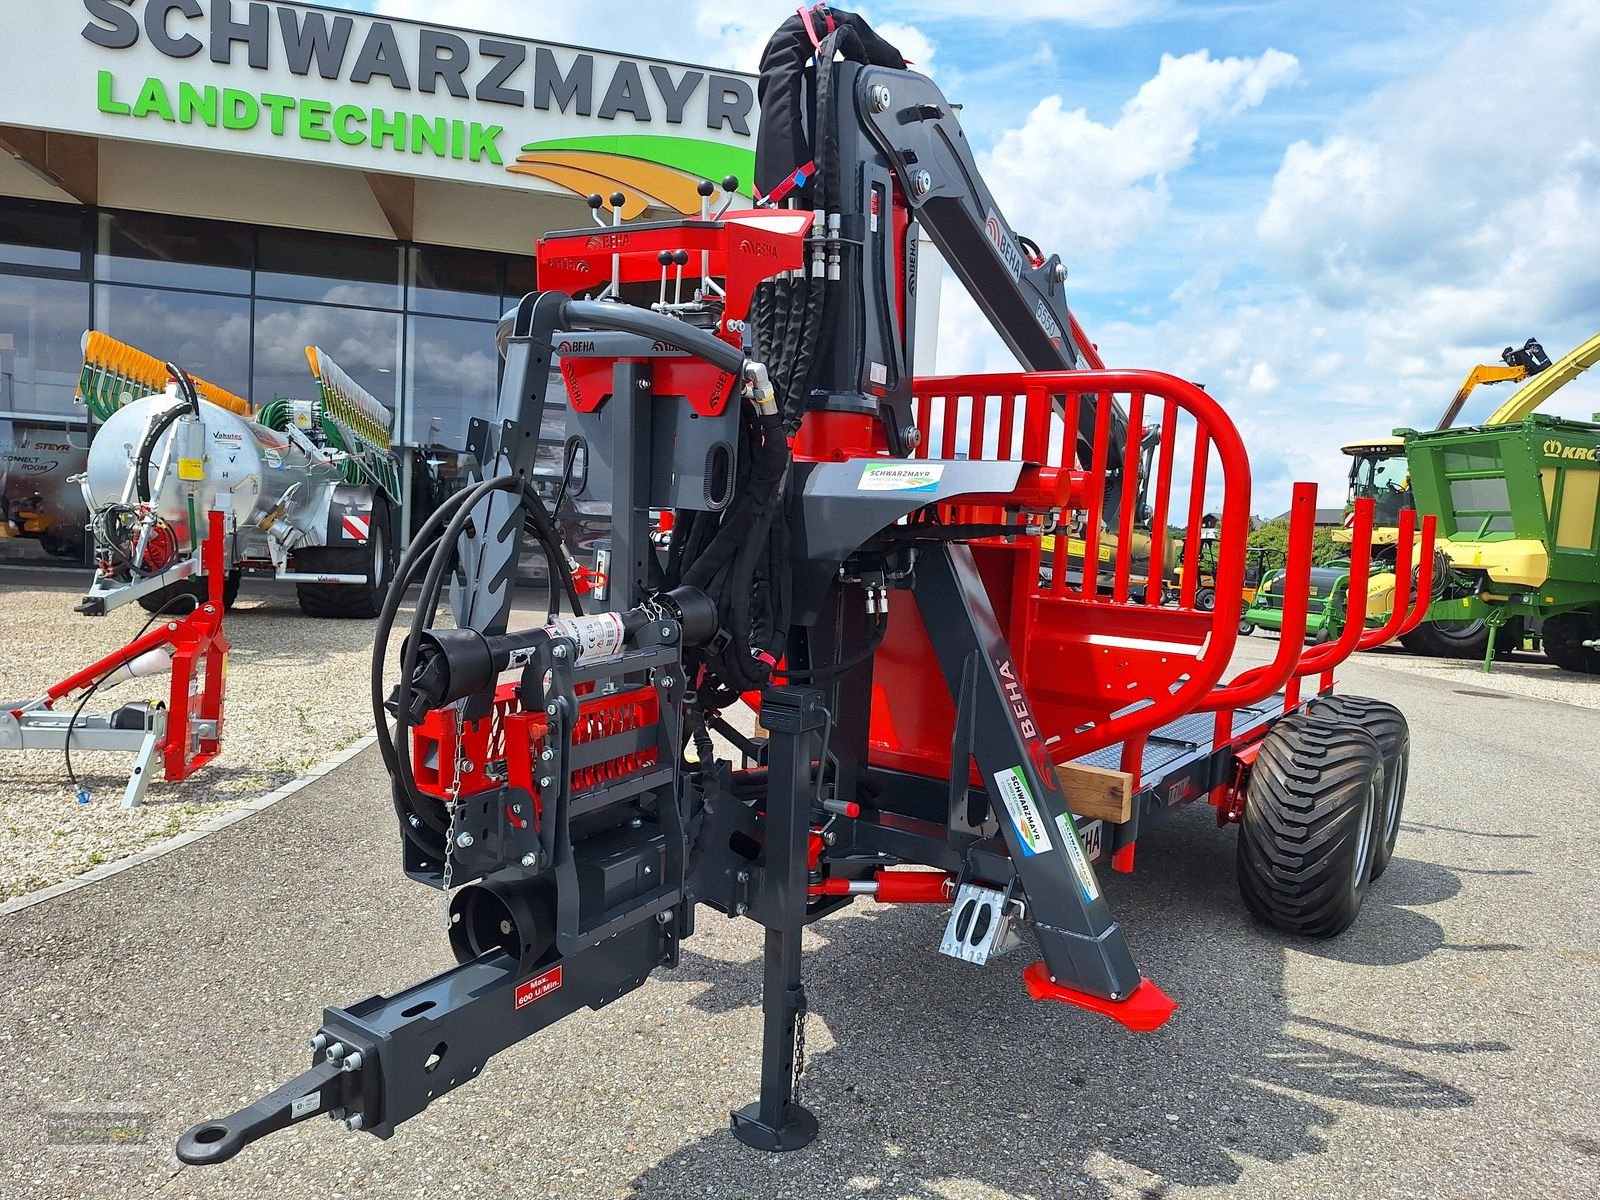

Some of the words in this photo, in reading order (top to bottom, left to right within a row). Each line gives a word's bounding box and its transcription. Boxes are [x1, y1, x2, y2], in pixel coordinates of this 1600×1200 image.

[81, 0, 756, 136] SCHWARZMAYR
[97, 70, 503, 165] LANDTECHNIK
[755, 242, 778, 259] BEHA
[909, 238, 917, 272] BEHA
[1000, 234, 1021, 279] BEHA
[1037, 303, 1056, 337] 6550
[572, 341, 595, 353] BEHA
[570, 376, 583, 407] BEHA
[34, 442, 71, 452] STEYR
[213, 431, 243, 440] Vakutec
[2, 455, 40, 463] CONNECT
[229, 455, 236, 463] V
[222, 471, 229, 479] H
[1000, 660, 1037, 739] BEHA
[1011, 775, 1041, 841] SCHWARZMAYR
[518, 992, 533, 1005] 600
[535, 981, 560, 996] U/Min.
[530, 977, 549, 989] Max.
